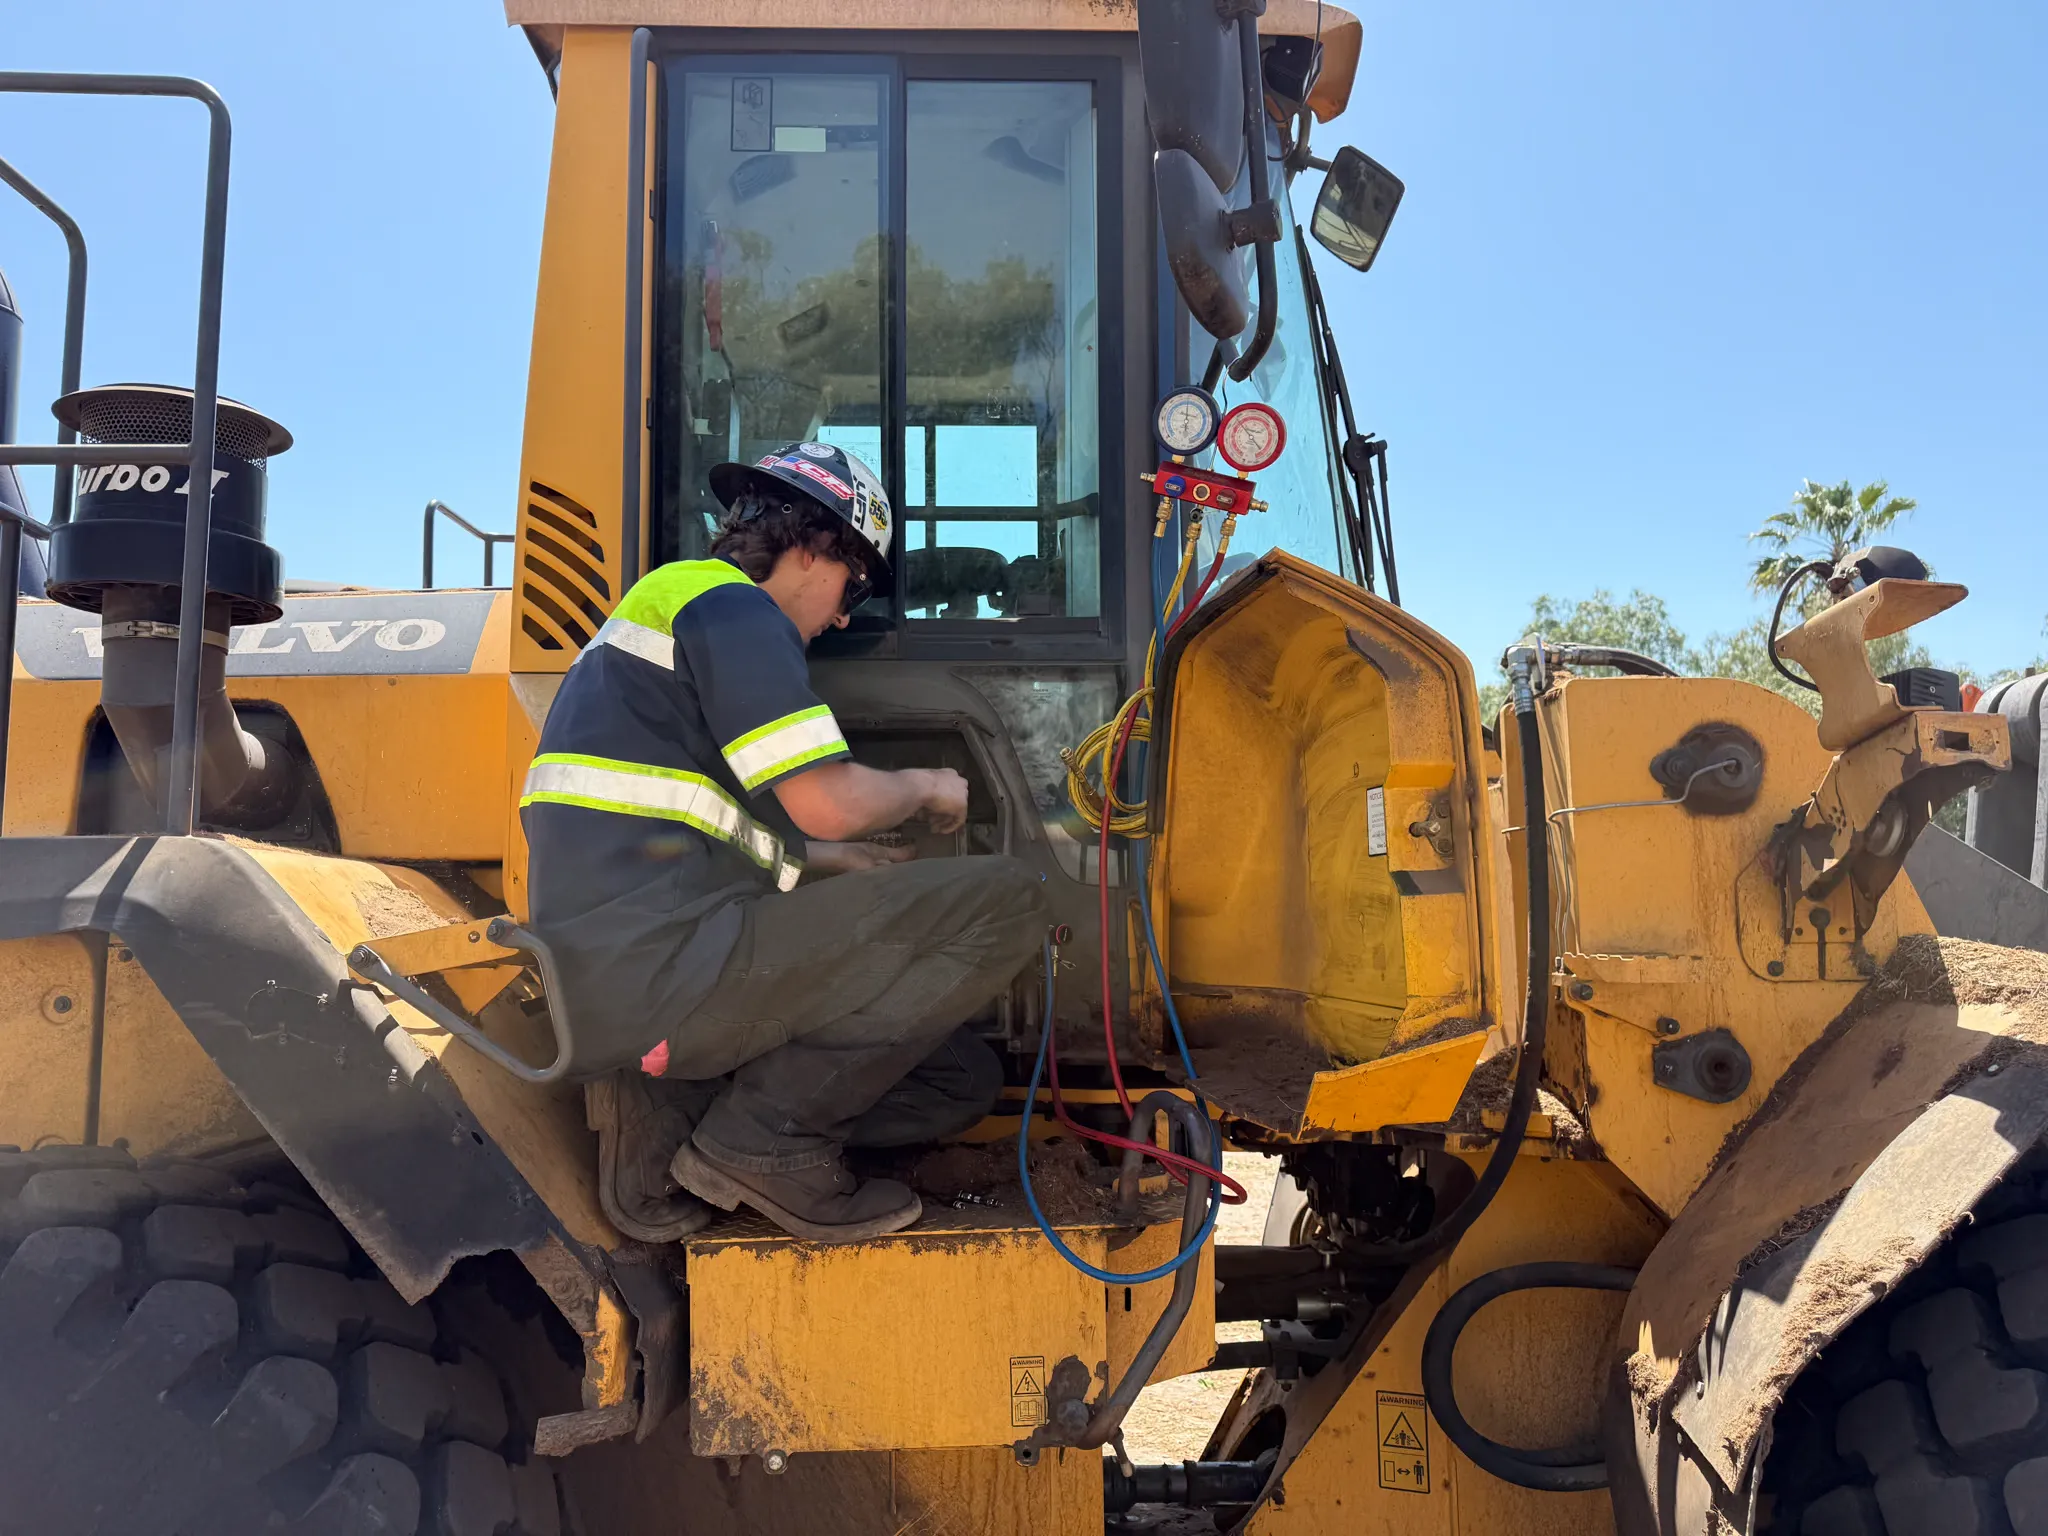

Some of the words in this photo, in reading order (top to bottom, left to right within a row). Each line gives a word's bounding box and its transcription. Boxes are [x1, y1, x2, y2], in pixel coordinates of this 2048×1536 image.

[78, 464, 170, 497] urbo
[71, 618, 446, 658] LVO
[1386, 1395, 1425, 1407] WARNING
